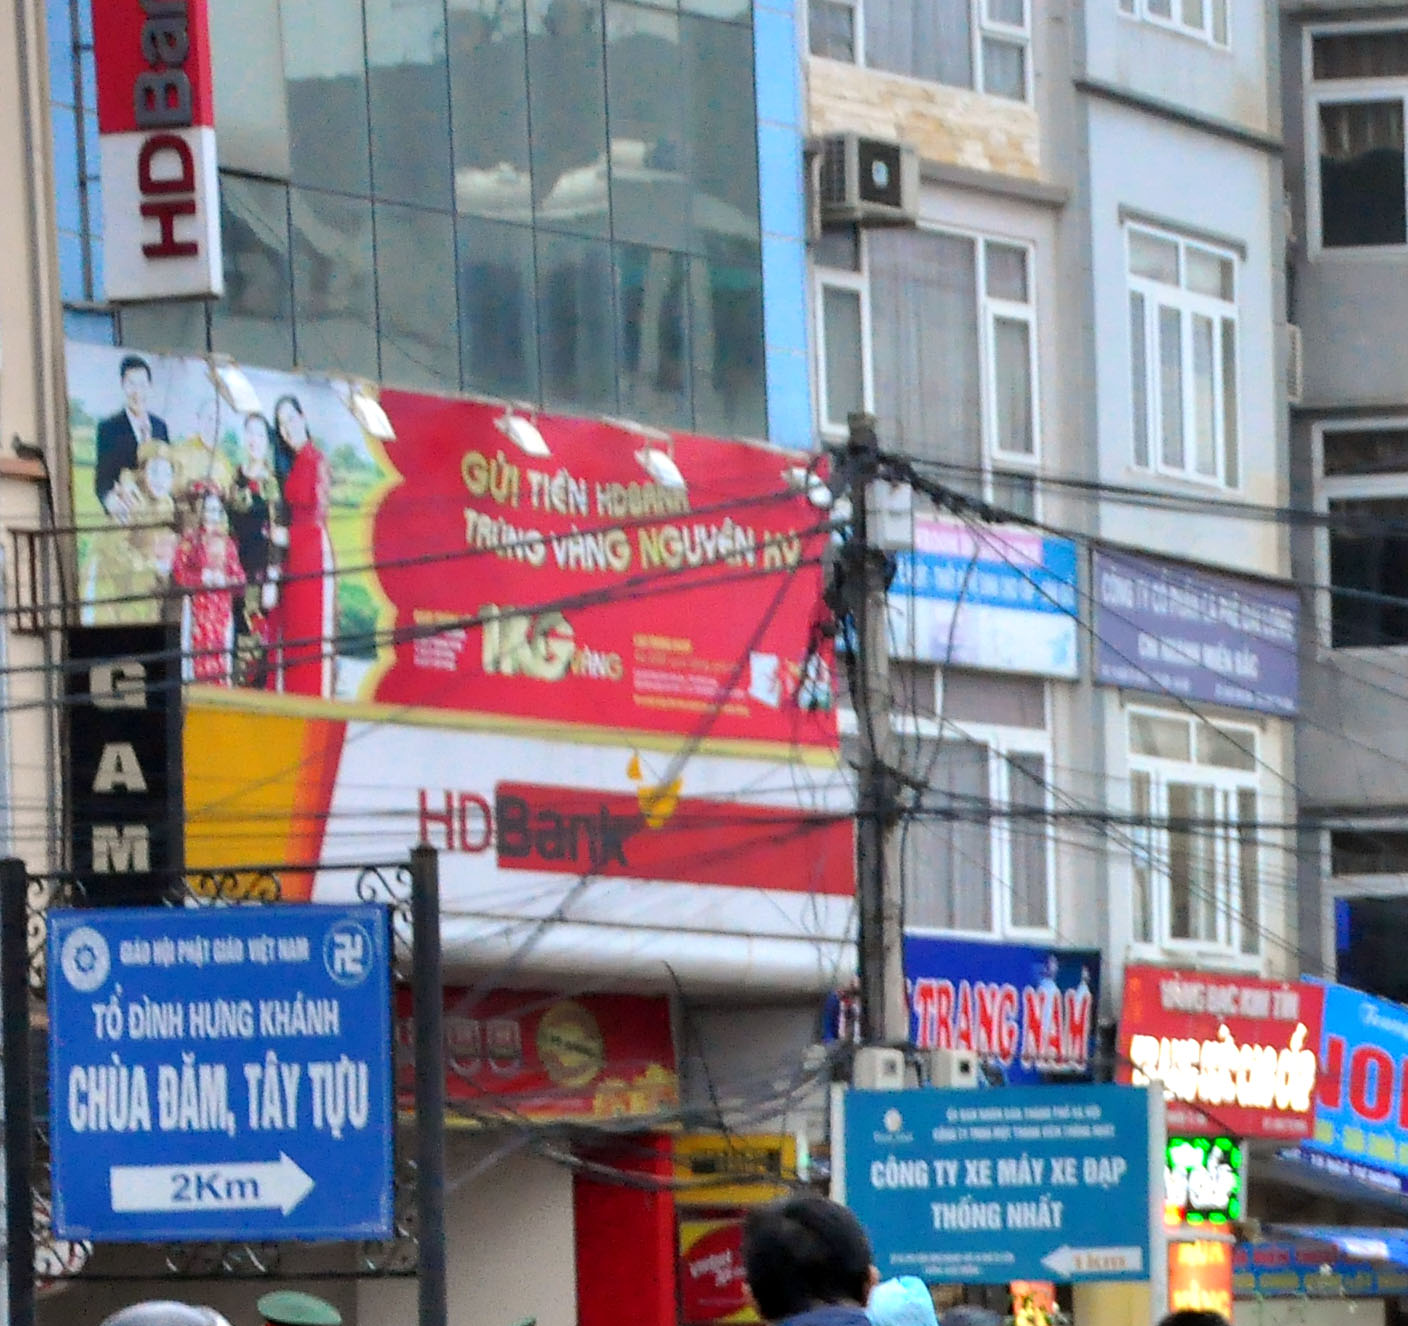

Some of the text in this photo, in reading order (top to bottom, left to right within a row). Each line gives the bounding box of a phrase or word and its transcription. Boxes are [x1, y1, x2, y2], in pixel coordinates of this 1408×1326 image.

[417, 786, 640, 867] HDBank
[92, 982, 124, 1040] TỔ
[128, 995, 184, 1040] ĐÌNH
[258, 991, 340, 1037] KHÁNH
[914, 976, 1019, 1067] TRANG
[1020, 984, 1093, 1073] NAM
[69, 1051, 152, 1133] CHÙA
[243, 1049, 301, 1130] TÂY
[170, 1173, 260, 1202] 2Km
[870, 1153, 929, 1189] CÔNG
[933, 1159, 959, 1187] TY
[964, 1158, 992, 1186] XE
[997, 1152, 1045, 1186] MÁY
[1050, 1156, 1078, 1186] XE
[1083, 1155, 1127, 1189] ĐẠP
[931, 1192, 1064, 1230] THỐNG NHẤT
